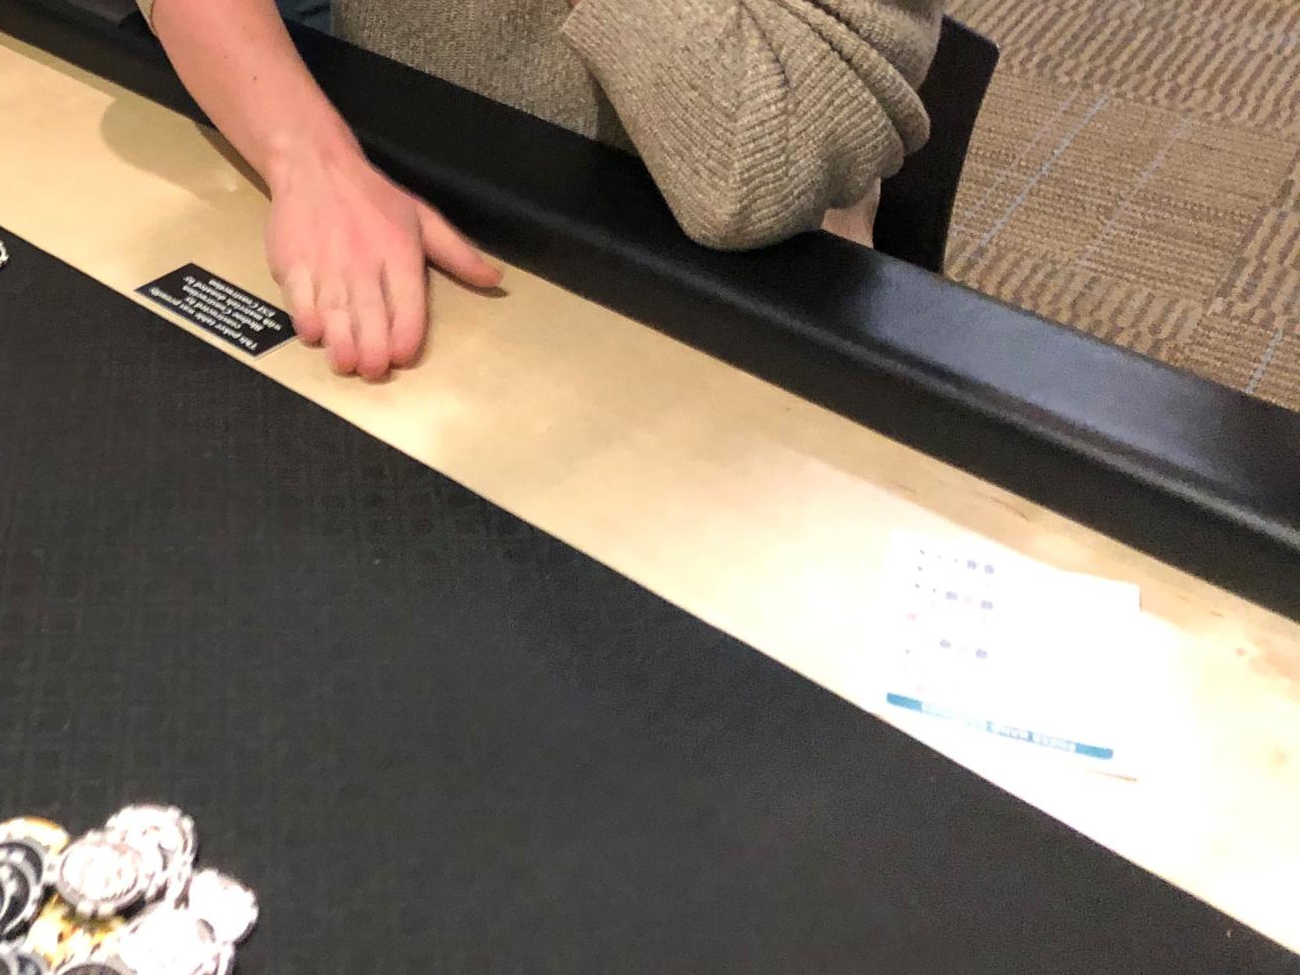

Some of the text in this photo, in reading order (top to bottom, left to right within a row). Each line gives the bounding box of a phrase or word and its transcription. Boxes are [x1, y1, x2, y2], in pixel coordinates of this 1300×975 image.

[183, 285, 231, 314] Construction
[209, 280, 258, 308] Construction
[180, 302, 195, 314] was
[195, 313, 215, 325] table
[215, 324, 241, 338] poker
[239, 337, 257, 350] This
